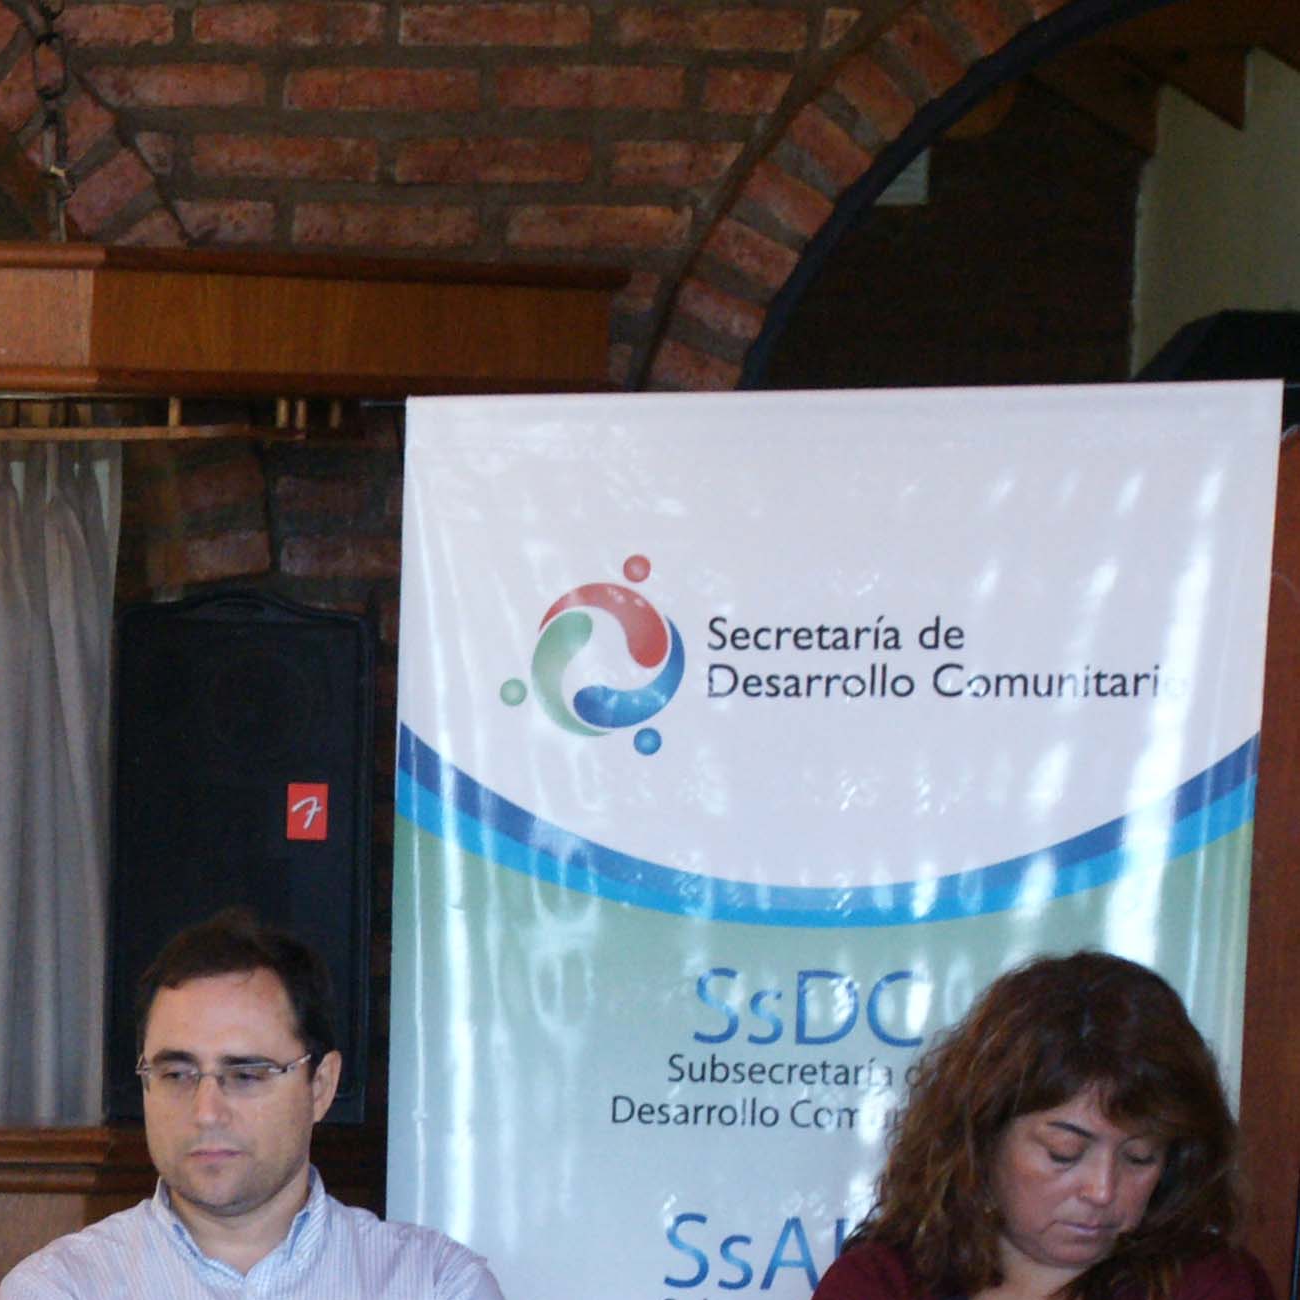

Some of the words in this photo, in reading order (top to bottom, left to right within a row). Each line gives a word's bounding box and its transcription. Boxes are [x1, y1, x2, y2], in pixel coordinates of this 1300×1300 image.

[707, 615, 901, 651] Secretaría
[918, 616, 966, 650] de
[707, 663, 915, 698] Desarrollo
[932, 663, 1185, 699] Comunitari
[693, 967, 925, 1047] SsDC
[610, 1095, 780, 1129] Desarrollo
